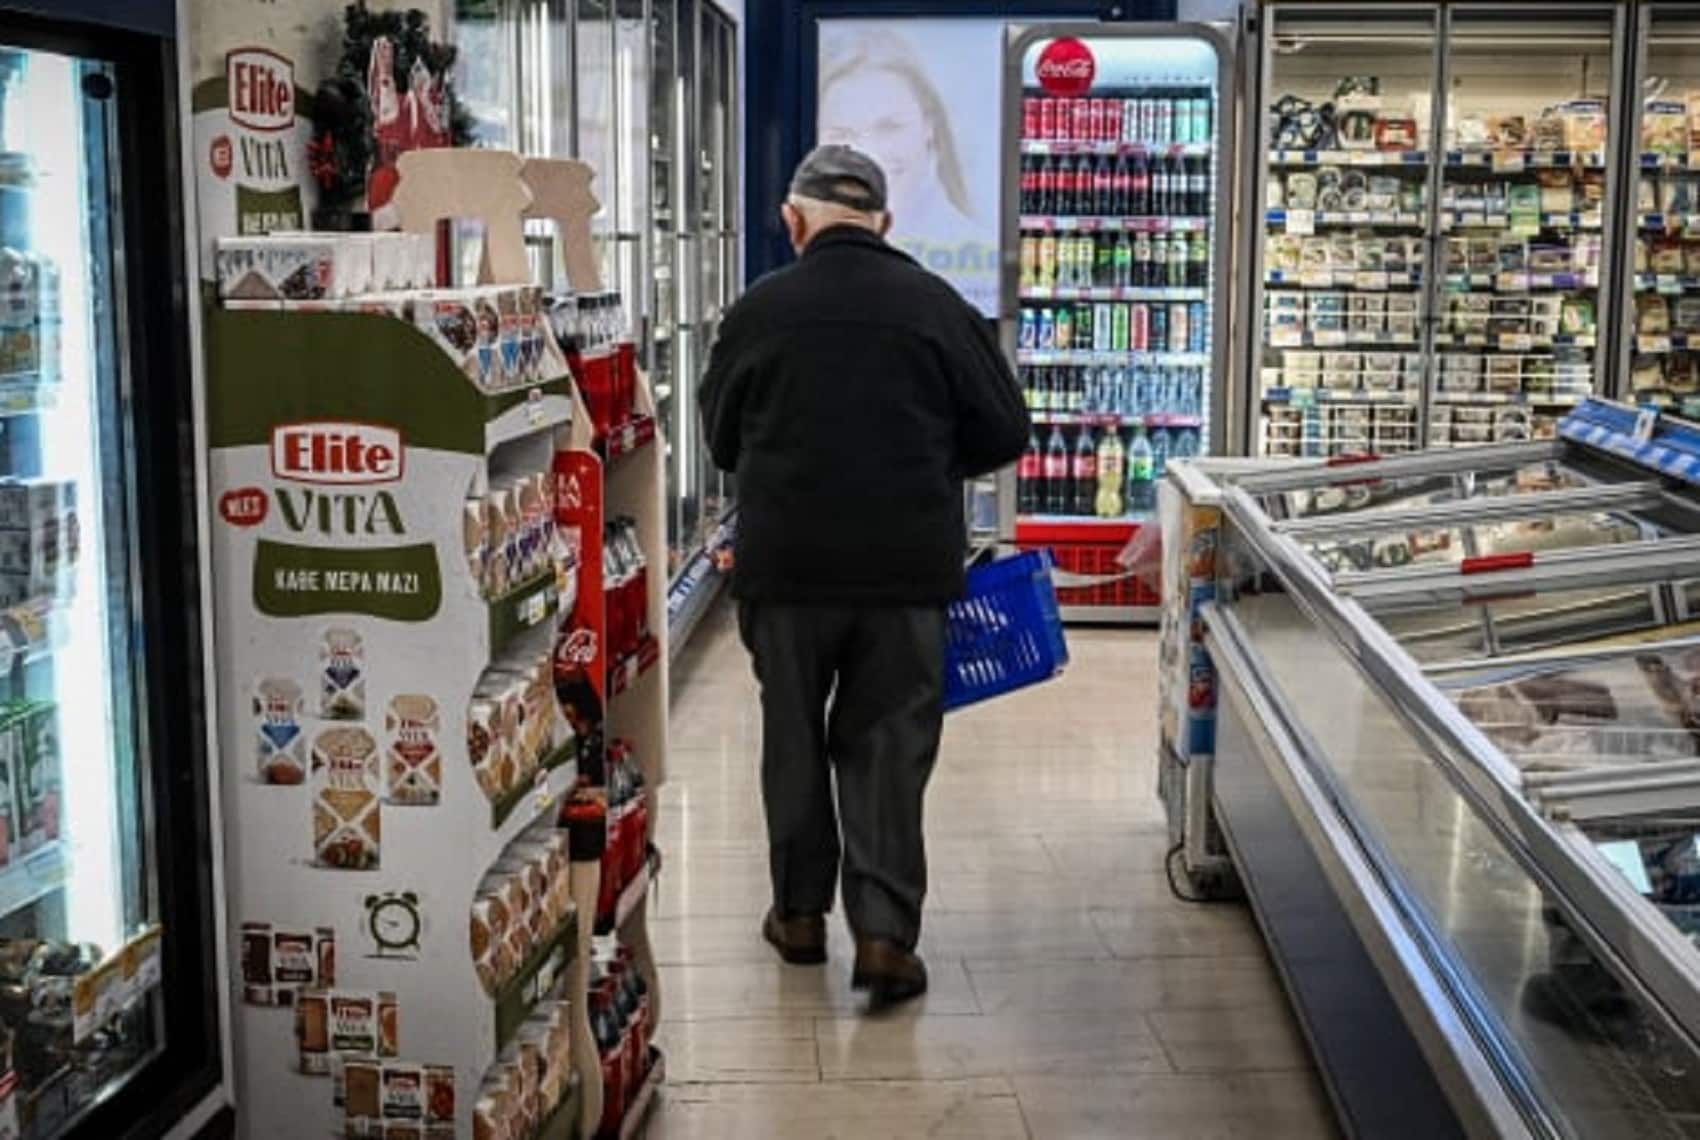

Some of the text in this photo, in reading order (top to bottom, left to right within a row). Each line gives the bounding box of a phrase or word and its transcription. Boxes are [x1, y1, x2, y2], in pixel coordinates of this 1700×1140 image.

[235, 62, 289, 116] Elite
[240, 135, 289, 179] VITA
[284, 432, 394, 473] Elite
[274, 487, 406, 534] VITA
